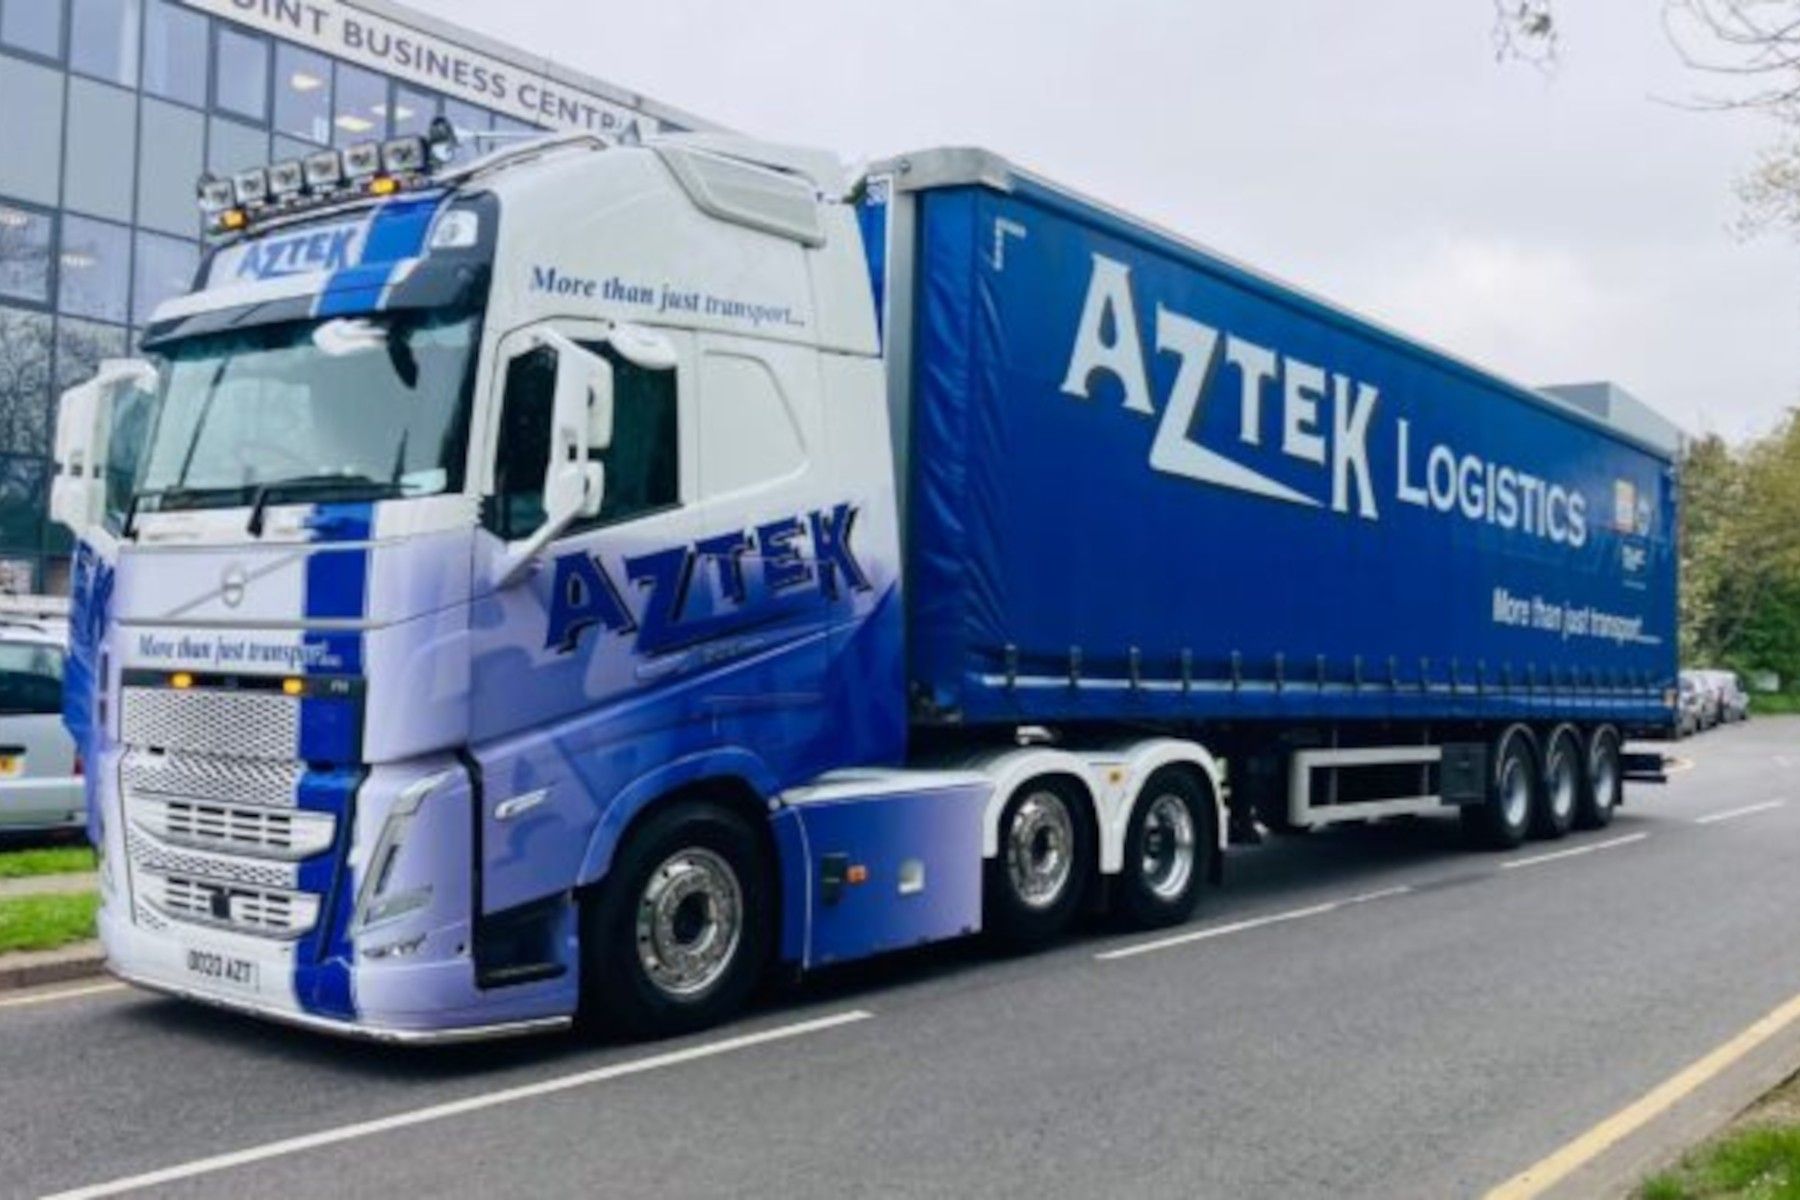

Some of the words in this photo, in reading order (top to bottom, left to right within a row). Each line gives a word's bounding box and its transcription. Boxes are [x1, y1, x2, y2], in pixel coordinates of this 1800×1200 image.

[343, 18, 507, 100] BUSINESS
[236, 224, 358, 280] AZTEK
[530, 265, 597, 297] More
[602, 276, 655, 306] than
[658, 283, 699, 313] just
[1060, 251, 1379, 520] AZTEK
[1396, 417, 1588, 548] LOGISTICS
[543, 503, 874, 659] AZTEK
[138, 632, 174, 659] More
[177, 633, 211, 661] than
